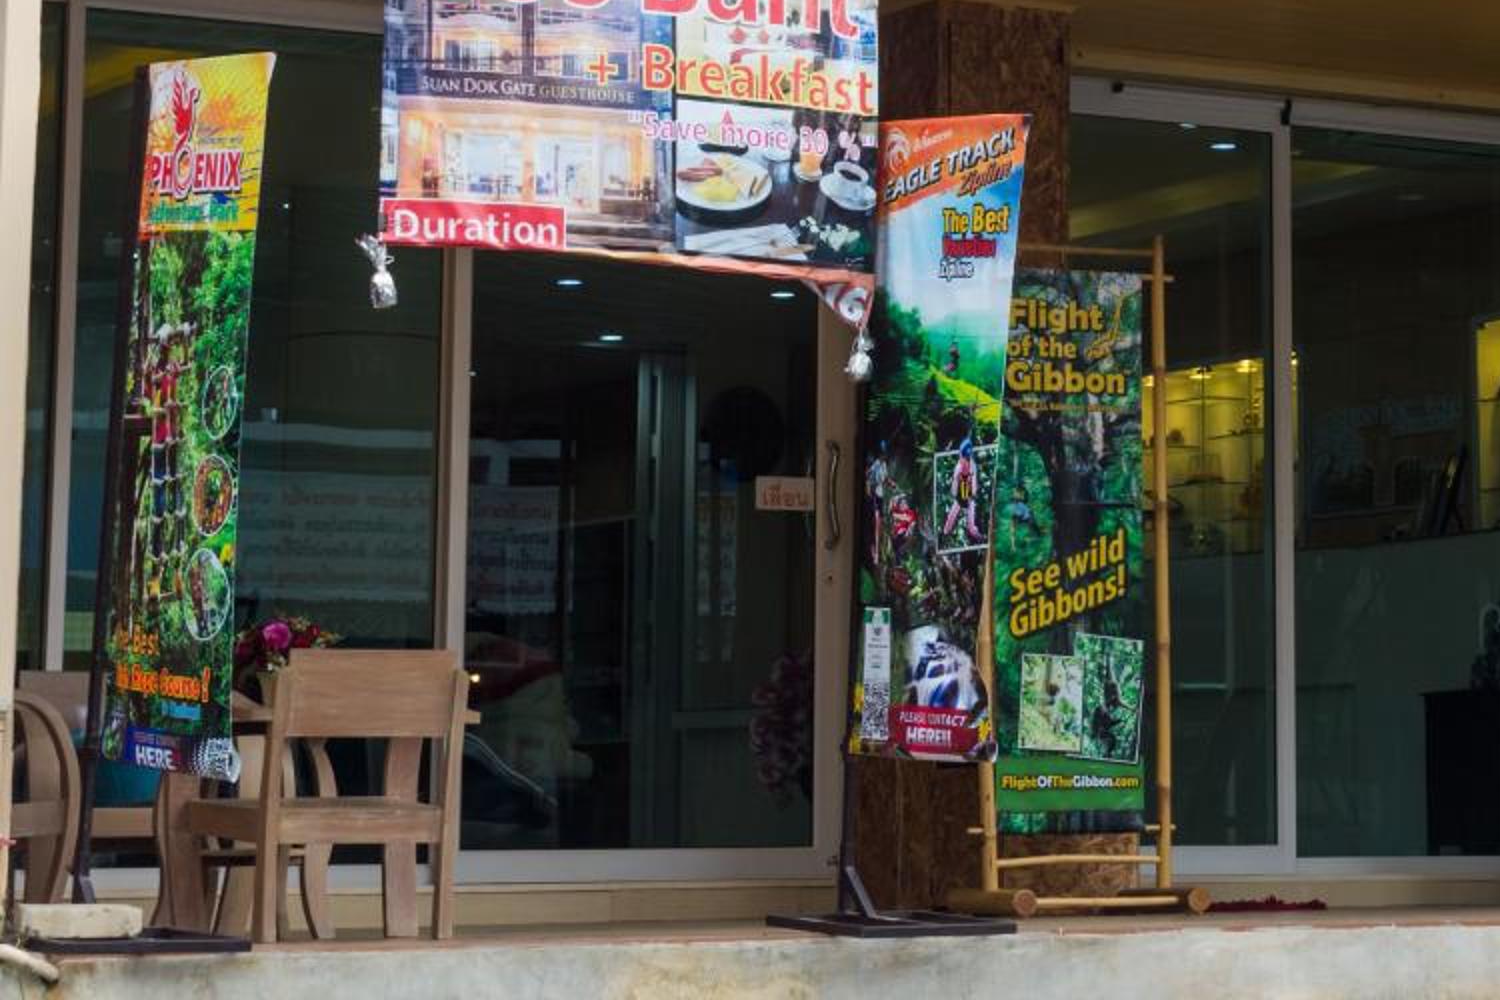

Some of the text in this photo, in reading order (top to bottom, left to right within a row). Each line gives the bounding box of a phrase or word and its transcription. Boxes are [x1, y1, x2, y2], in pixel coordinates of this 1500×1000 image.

[421, 75, 636, 103] SUAN DOK GATE GUESTHOUSE
[642, 43, 875, 114] Breakfast
[719, 120, 791, 150] more
[145, 150, 242, 198] PHOENIX
[884, 158, 943, 203] EAGLE
[946, 126, 1016, 176] TRACK
[391, 207, 560, 248] Duration
[943, 202, 1011, 234] The Best
[1009, 298, 1105, 334] Flight
[1006, 335, 1077, 360] of the
[1006, 358, 1126, 397] Gibbon
[1010, 528, 1126, 603] See wild
[1009, 564, 1127, 640] Gibbons!
